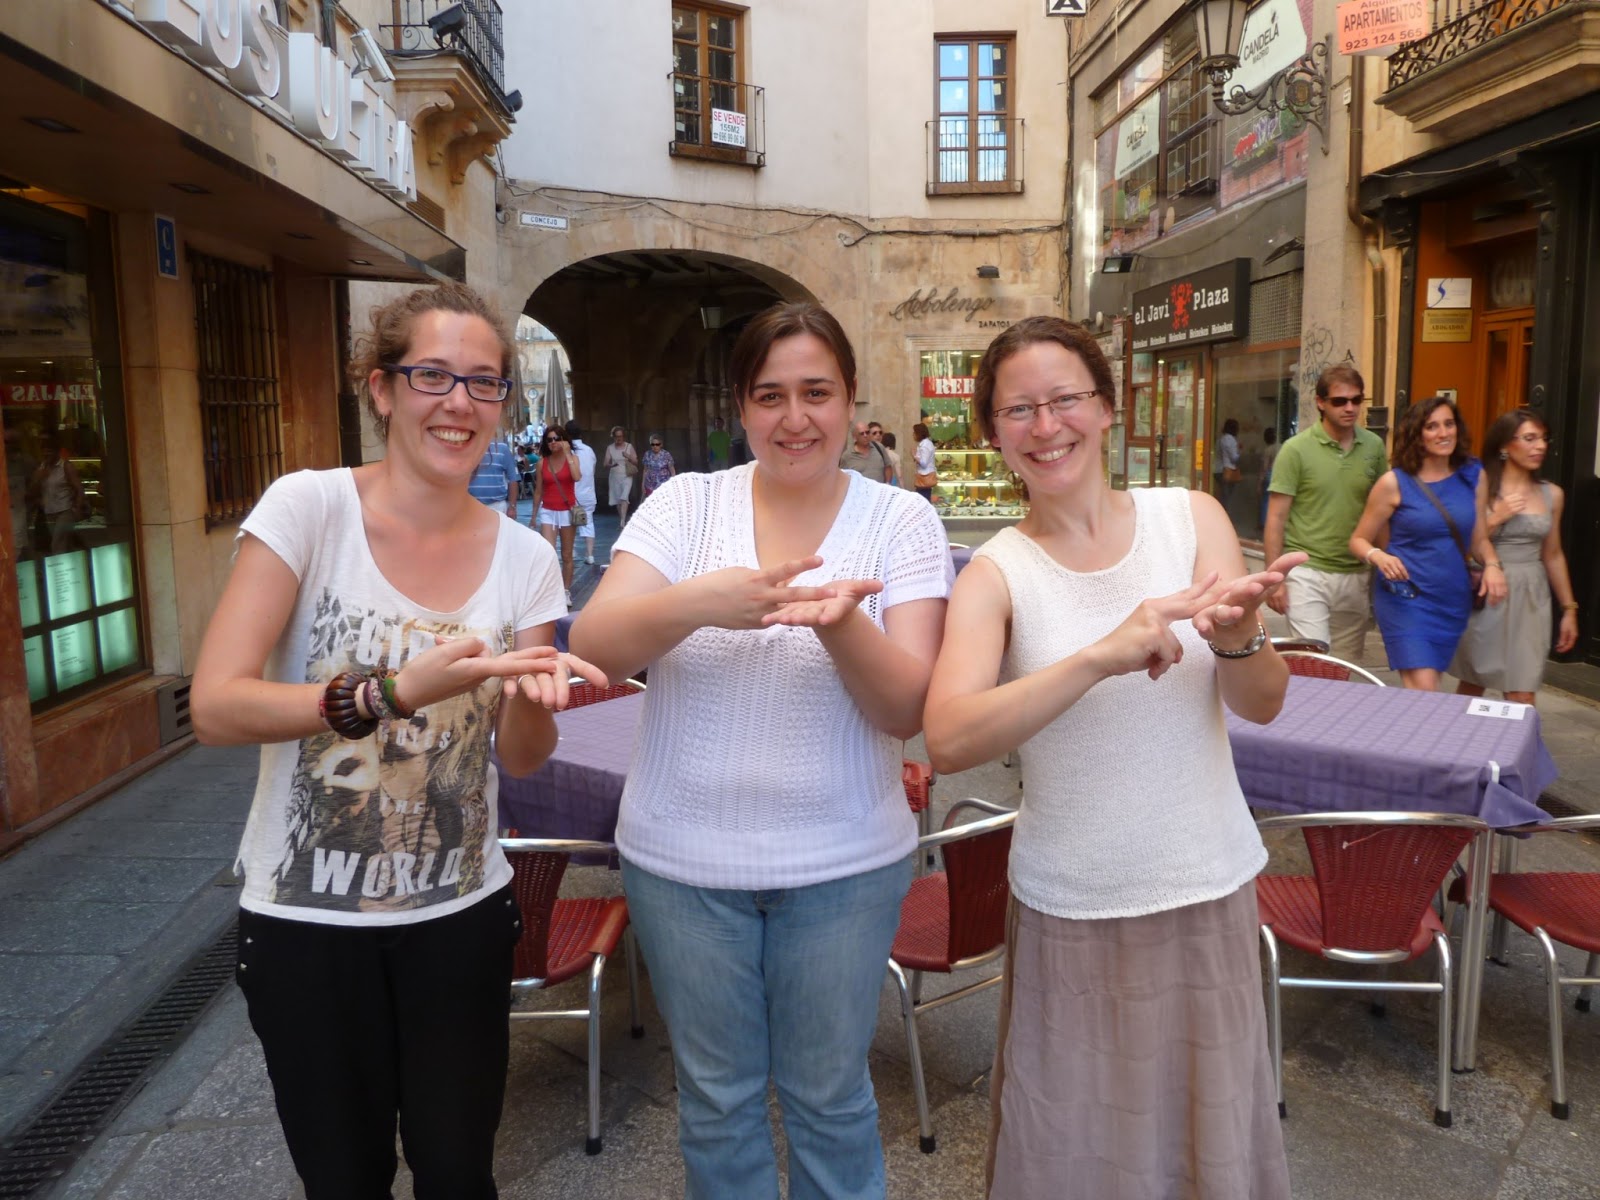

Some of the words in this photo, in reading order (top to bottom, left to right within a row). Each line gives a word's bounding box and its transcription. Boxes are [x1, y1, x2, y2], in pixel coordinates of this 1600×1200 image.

[1343, 1, 1423, 32] APARTAMENTOS
[1243, 23, 1280, 61] CANDELA
[1346, 38, 1368, 51] 923
[1373, 32, 1396, 45] 124
[1400, 27, 1423, 40] 565
[714, 111, 722, 121] SE
[724, 113, 745, 126] VENDE
[530, 216, 558, 226] CONCEJO
[889, 287, 996, 322] Abolengo
[1134, 306, 1146, 325] el
[1147, 298, 1170, 322] Javi
[1193, 286, 1230, 311] Plaza
[978, 320, 1010, 329] ZAPATOS
[1211, 321, 1233, 335] Heineken
[311, 846, 466, 898] WORLD
